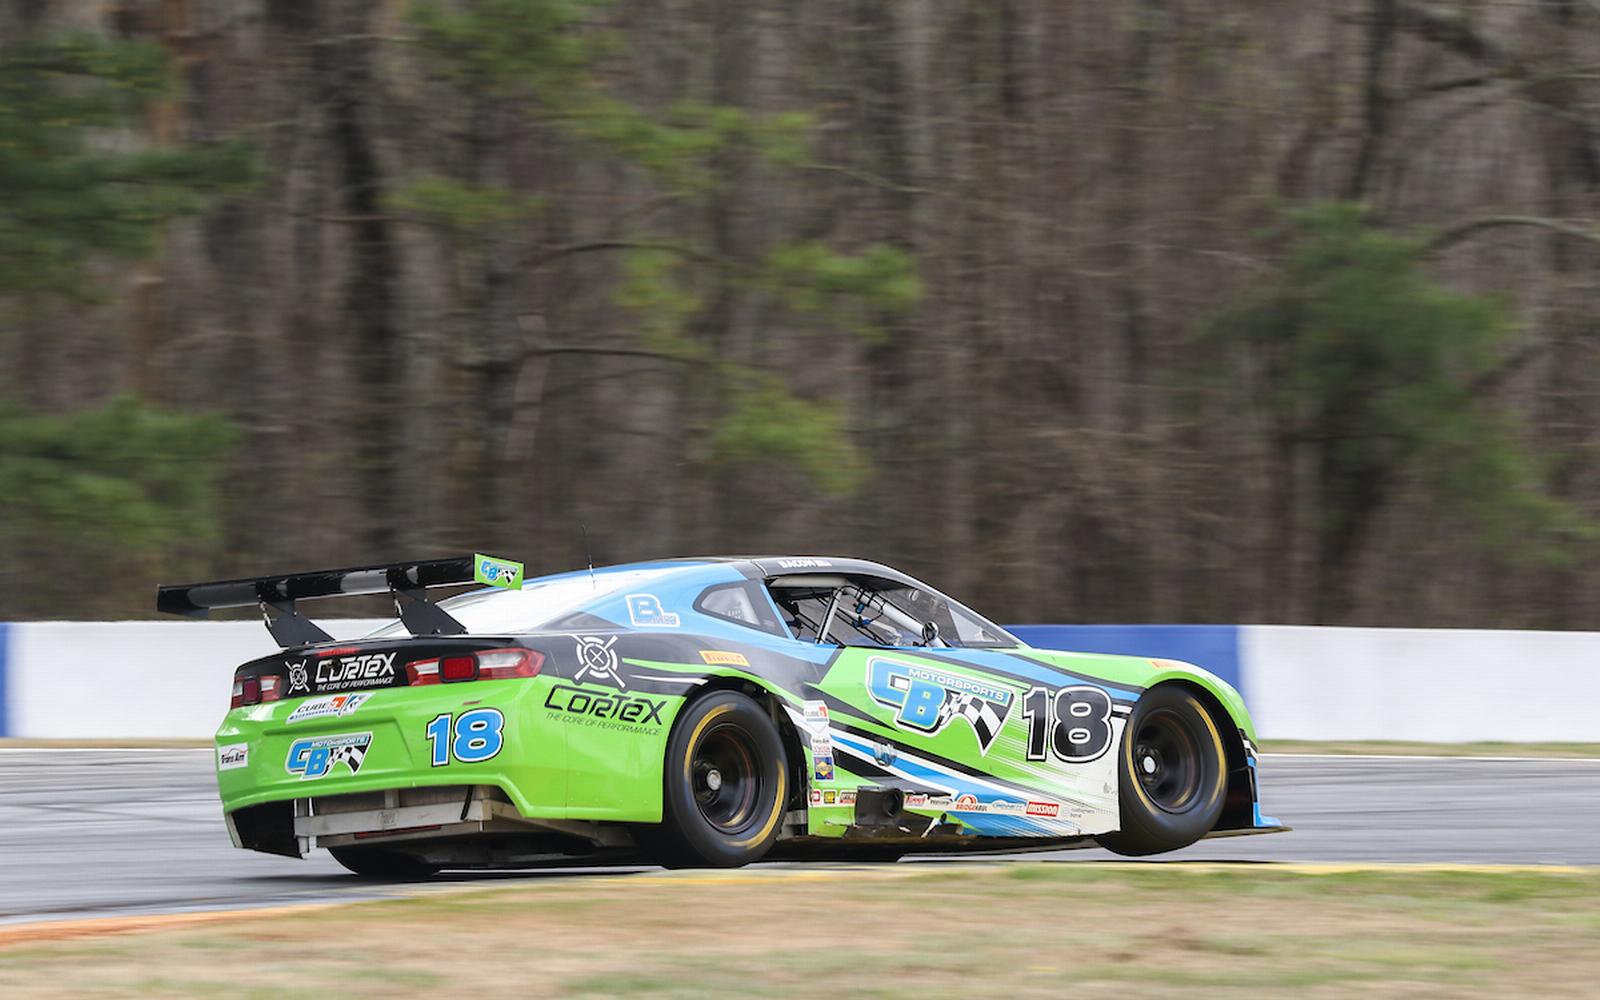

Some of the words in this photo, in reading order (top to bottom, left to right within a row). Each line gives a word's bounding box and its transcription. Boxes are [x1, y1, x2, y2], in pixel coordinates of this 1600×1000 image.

[871, 660, 946, 728] CB
[908, 668, 1005, 701] MOTORSPORTS
[426, 707, 505, 768] 18
[546, 712, 561, 721] THE
[562, 714, 585, 725] CORE
[585, 718, 596, 727] OF
[597, 720, 662, 736] PERFORMANCE
[1022, 685, 1114, 763] 18
[287, 741, 331, 777] CB
[1028, 802, 1059, 816] MISSION
